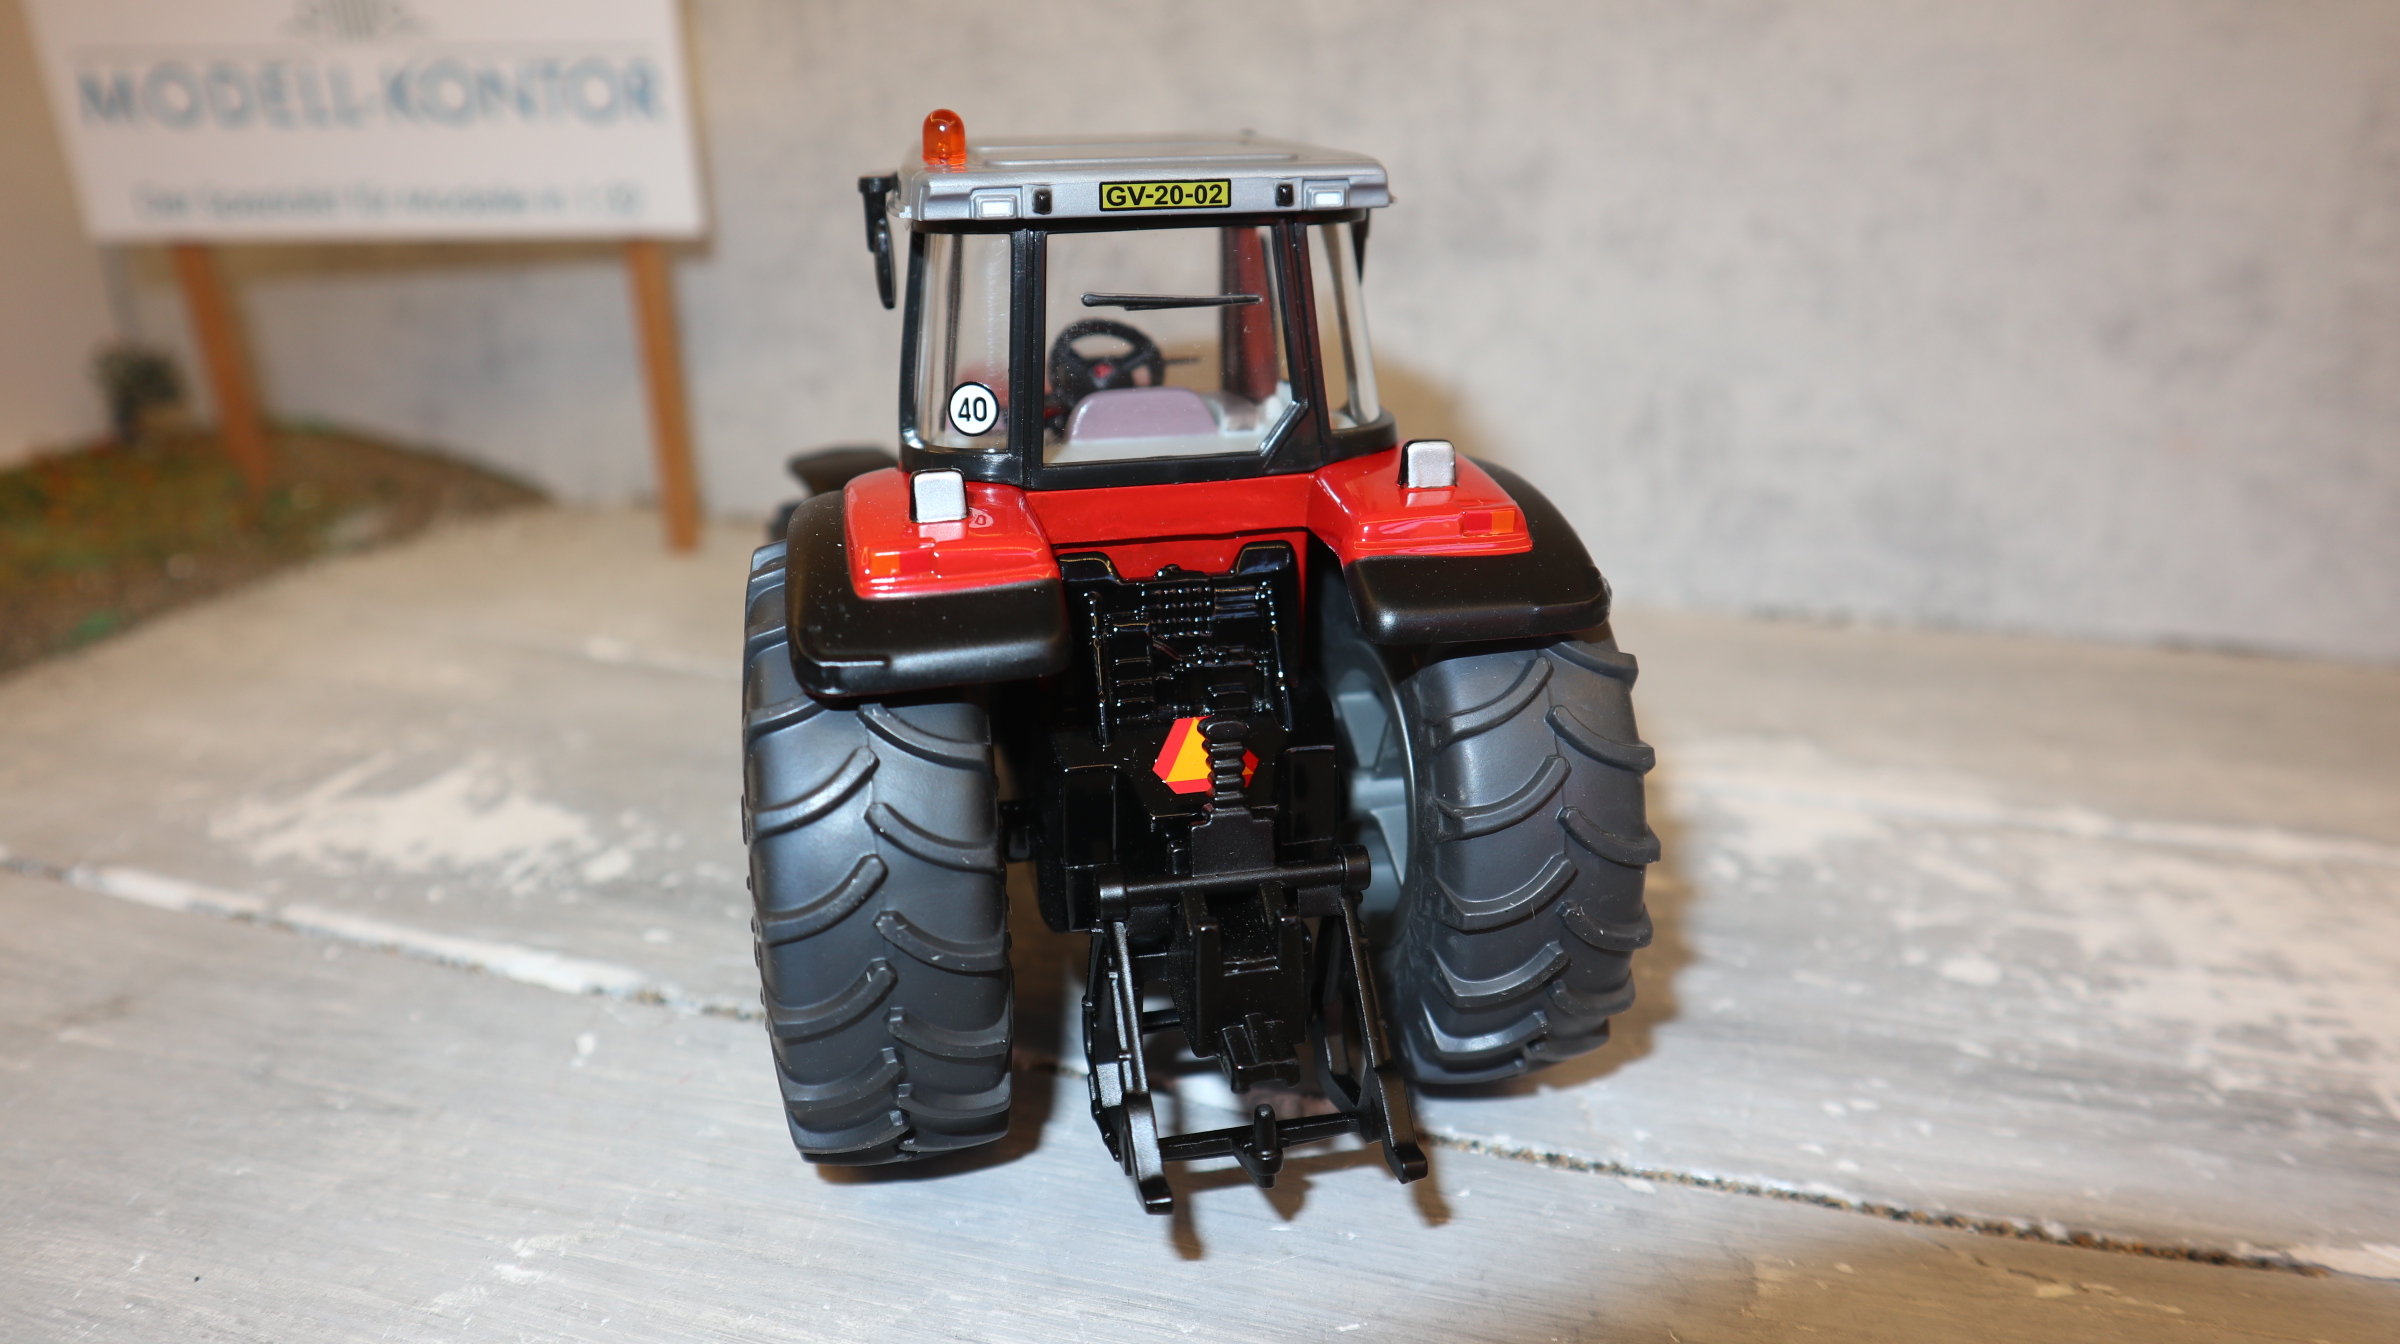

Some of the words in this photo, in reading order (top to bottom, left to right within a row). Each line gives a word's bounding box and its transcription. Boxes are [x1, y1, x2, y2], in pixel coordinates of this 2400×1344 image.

[76, 59, 665, 130] MODELL-KONTOR
[1106, 184, 1223, 206] GV-20-02
[958, 396, 987, 422] 40
